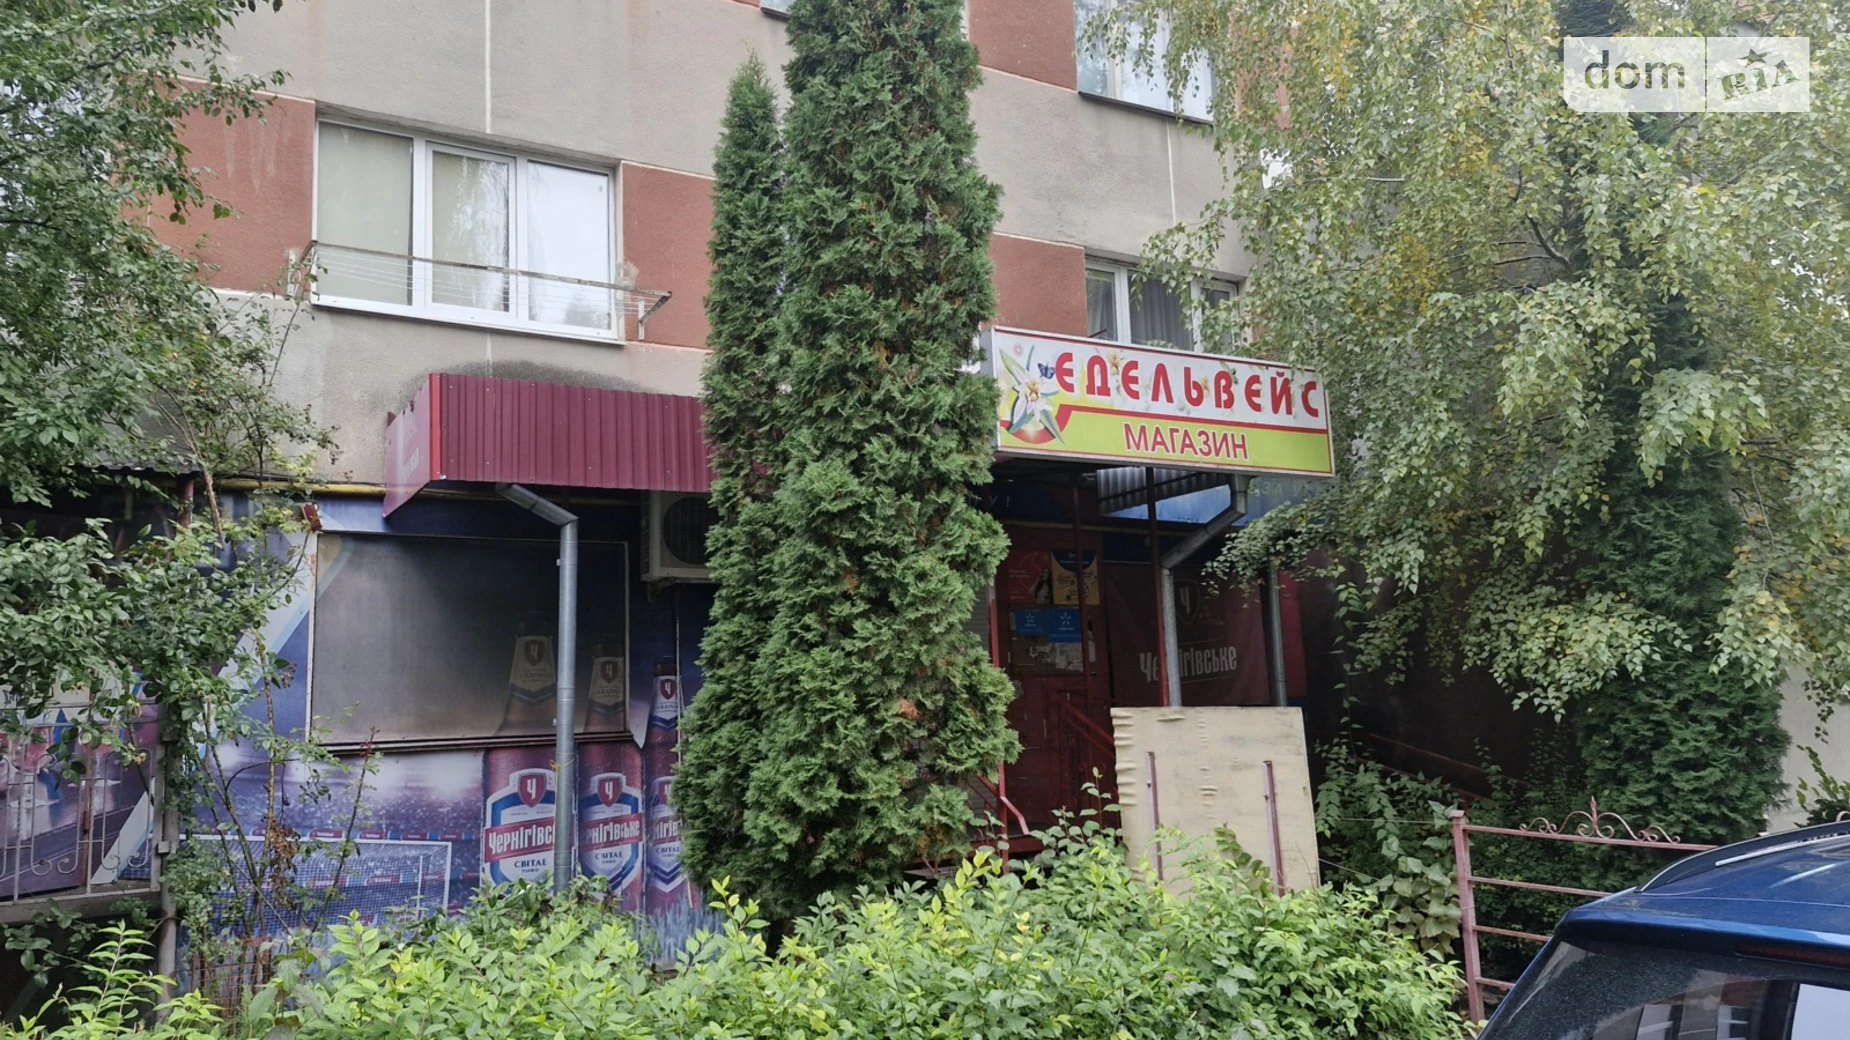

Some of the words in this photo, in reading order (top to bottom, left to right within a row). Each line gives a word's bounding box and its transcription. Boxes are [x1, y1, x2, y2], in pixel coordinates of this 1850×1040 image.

[1054, 351, 1319, 418] ЕДЕЛЬВЕЙС
[1124, 423, 1248, 460] МАГАЗИН
[1139, 645, 1238, 685] Чеігівське
[488, 823, 556, 856] Чернігівс
